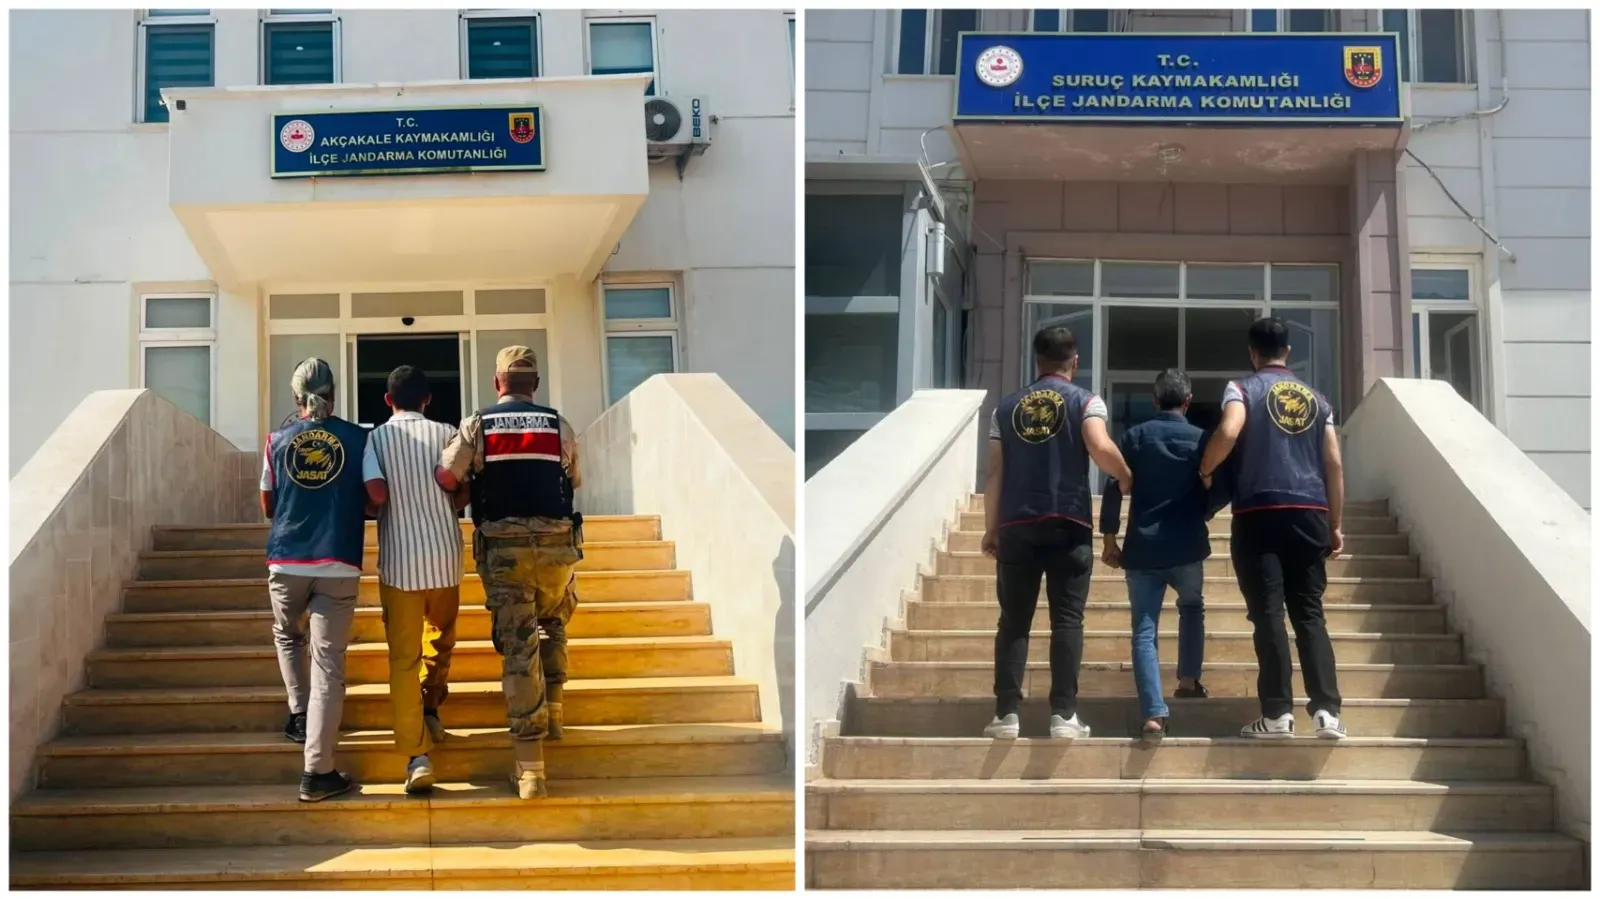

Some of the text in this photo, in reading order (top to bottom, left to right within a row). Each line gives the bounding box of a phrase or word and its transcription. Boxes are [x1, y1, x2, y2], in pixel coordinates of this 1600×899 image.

[1157, 54, 1200, 67] T.C.
[1051, 72, 1300, 90] SURUÇ KAYMAKAMLIĞI
[1014, 92, 1352, 110] İLÇE JANDARMA KOMUTANLIĞI
[395, 117, 419, 129] T.C.
[691, 98, 702, 138] BEKO
[320, 133, 392, 149] AKÇAKALE
[395, 129, 495, 144] KAYMAKAMLIĞI
[308, 146, 508, 167] İLÇE JANDARMA KOMUTANLIĞI
[490, 415, 551, 431] JANDARMA
[291, 430, 342, 450] JANDARMA
[296, 469, 330, 481] JASAT
